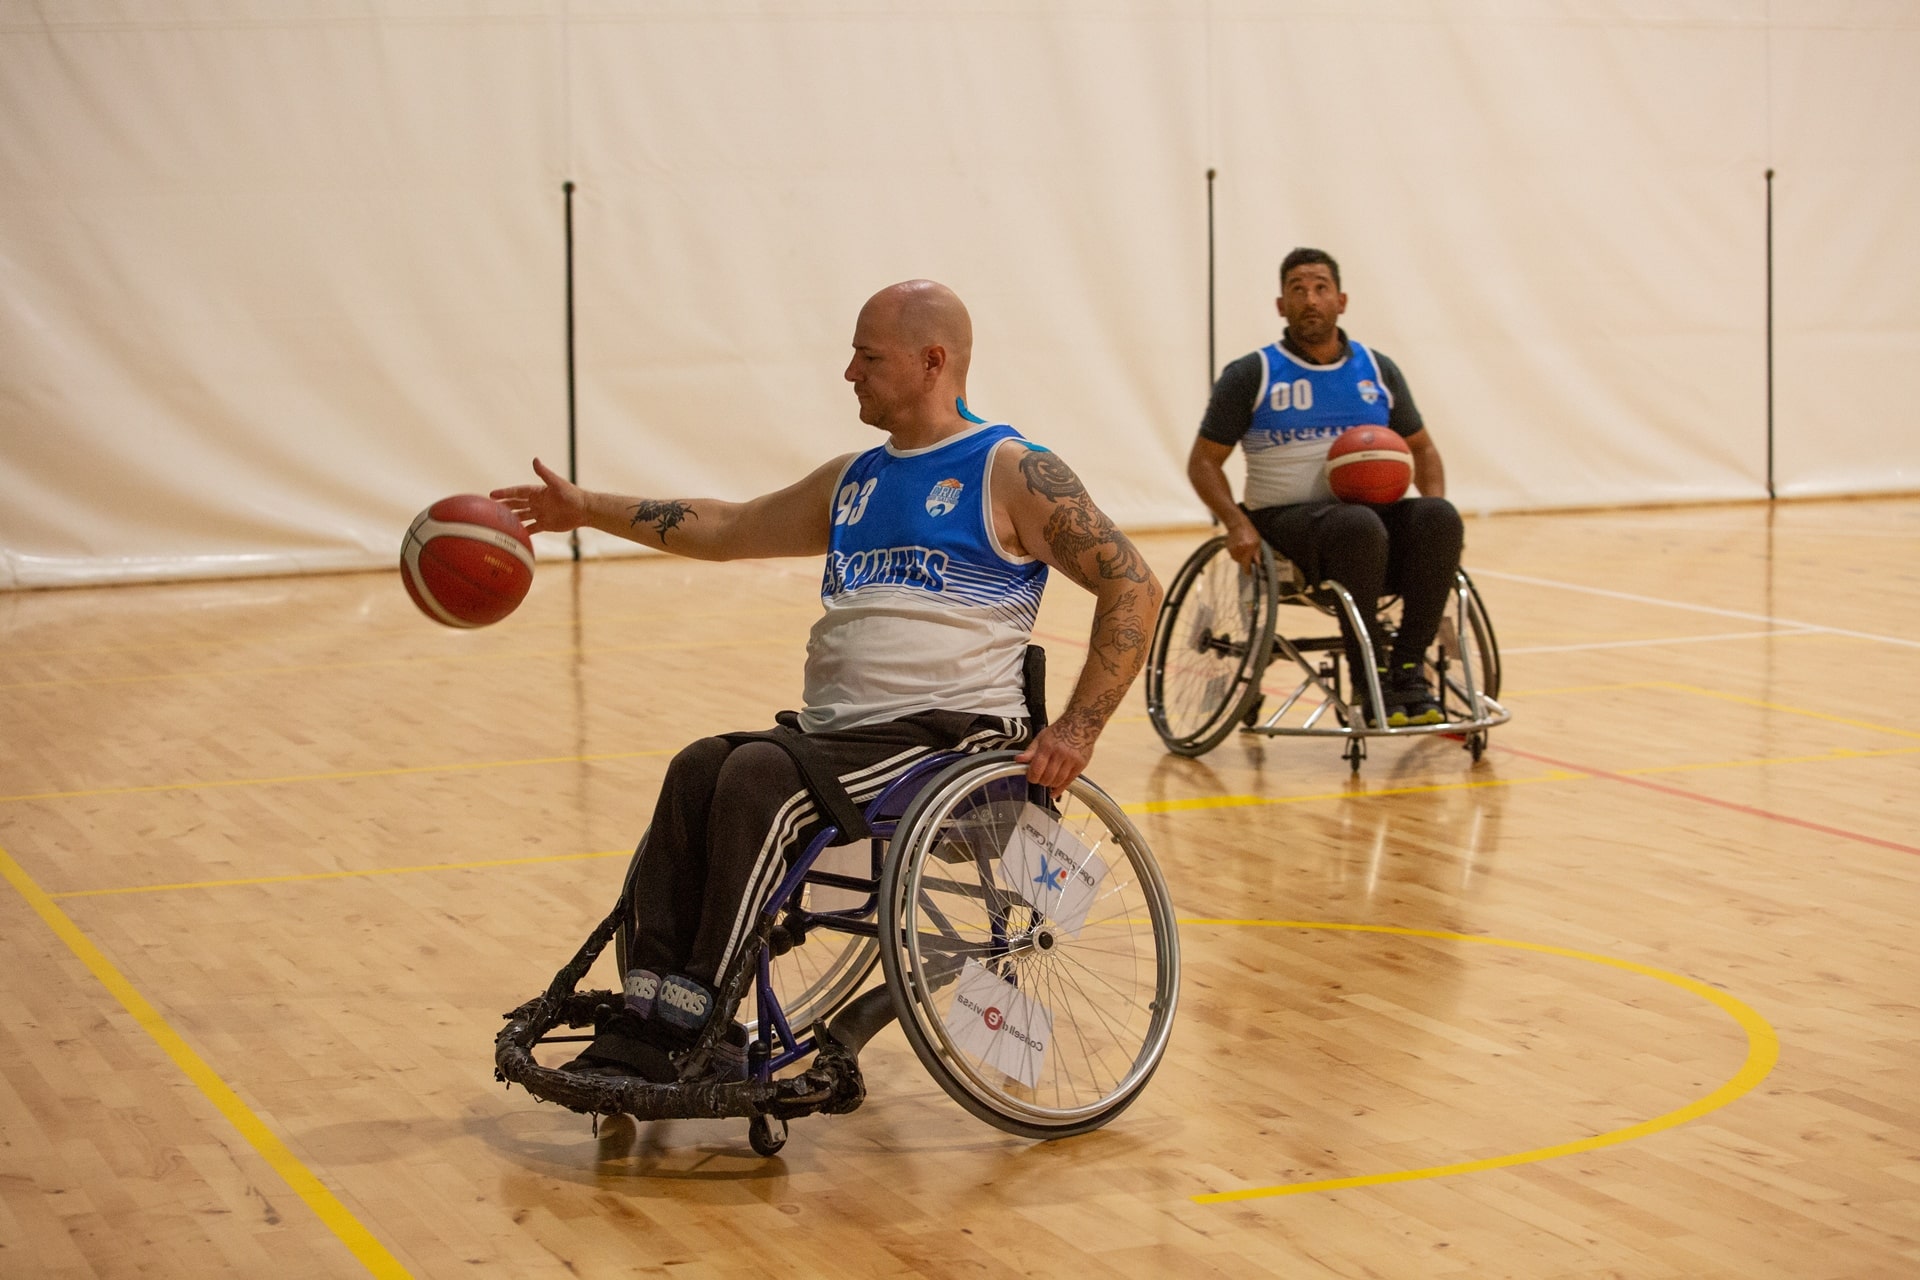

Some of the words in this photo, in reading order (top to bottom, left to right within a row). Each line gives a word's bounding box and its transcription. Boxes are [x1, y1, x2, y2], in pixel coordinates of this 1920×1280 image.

[1270, 378, 1313, 412] 00
[834, 477, 878, 526] 93
[1053, 848, 1077, 870] Social
[660, 980, 707, 1016] OSIRIS
